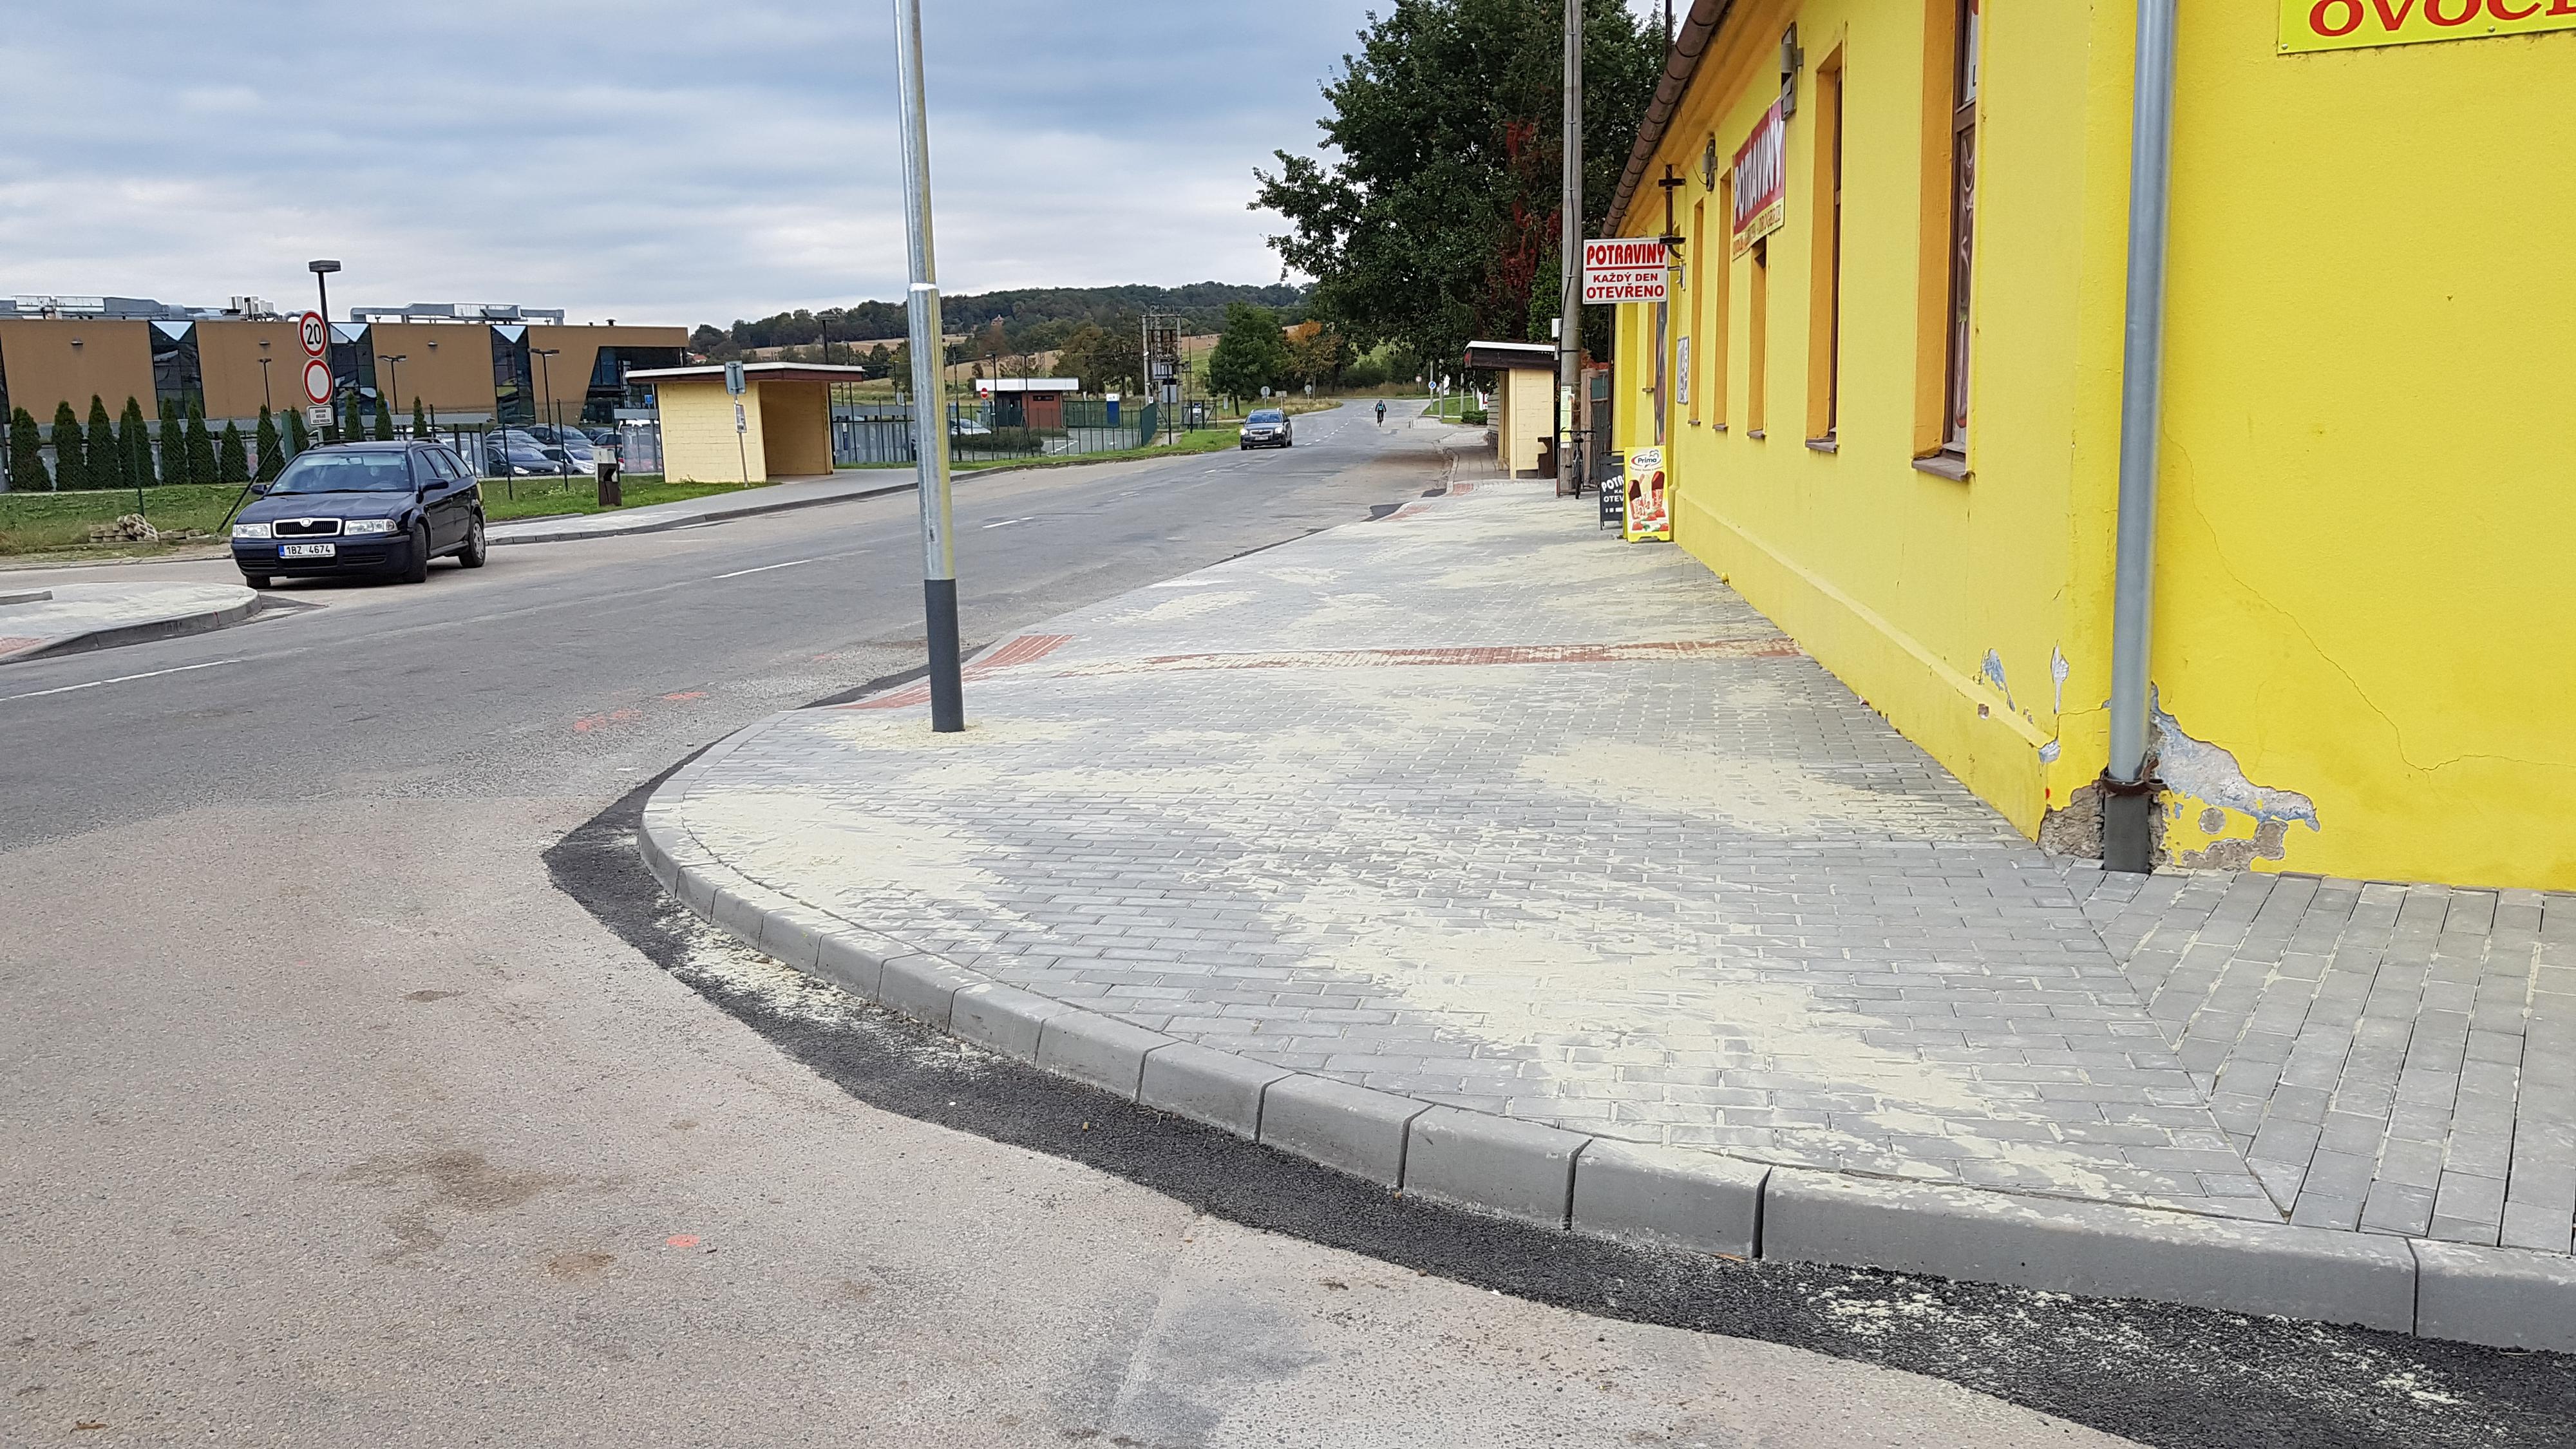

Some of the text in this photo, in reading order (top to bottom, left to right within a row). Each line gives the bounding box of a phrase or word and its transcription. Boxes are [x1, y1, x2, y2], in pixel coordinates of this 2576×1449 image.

[2309, 0, 2576, 37] OVOC
[1734, 118, 1784, 226] POTRAVINY
[1586, 243, 1665, 265] POTRAVINY
[1593, 272, 1658, 283] KAŽDÝ DEN
[1586, 283, 1664, 299] OTEVŘENO
[305, 323, 322, 345] 20
[1601, 473, 1624, 493] POTR
[287, 545, 330, 554] 1BZ 4674
